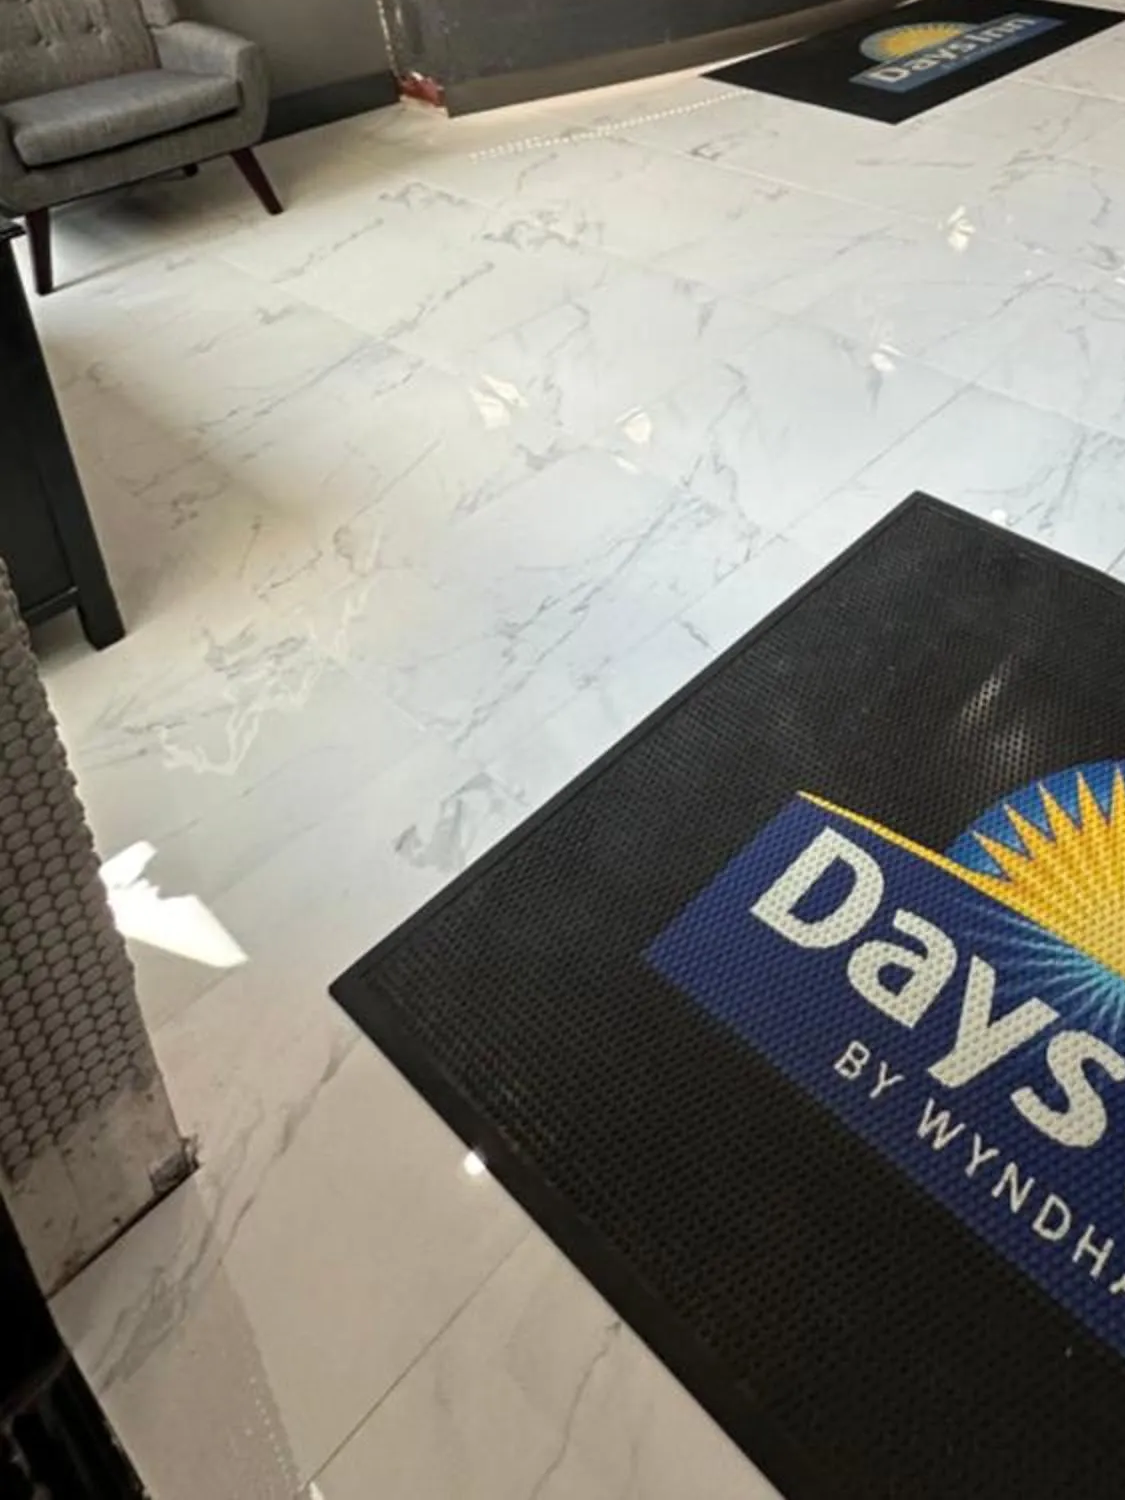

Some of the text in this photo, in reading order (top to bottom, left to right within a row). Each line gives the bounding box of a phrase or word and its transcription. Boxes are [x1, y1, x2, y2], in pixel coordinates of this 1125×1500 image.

[868, 41, 977, 83] Days
[965, 16, 1038, 43] Inn
[834, 1039, 904, 1101] BY
